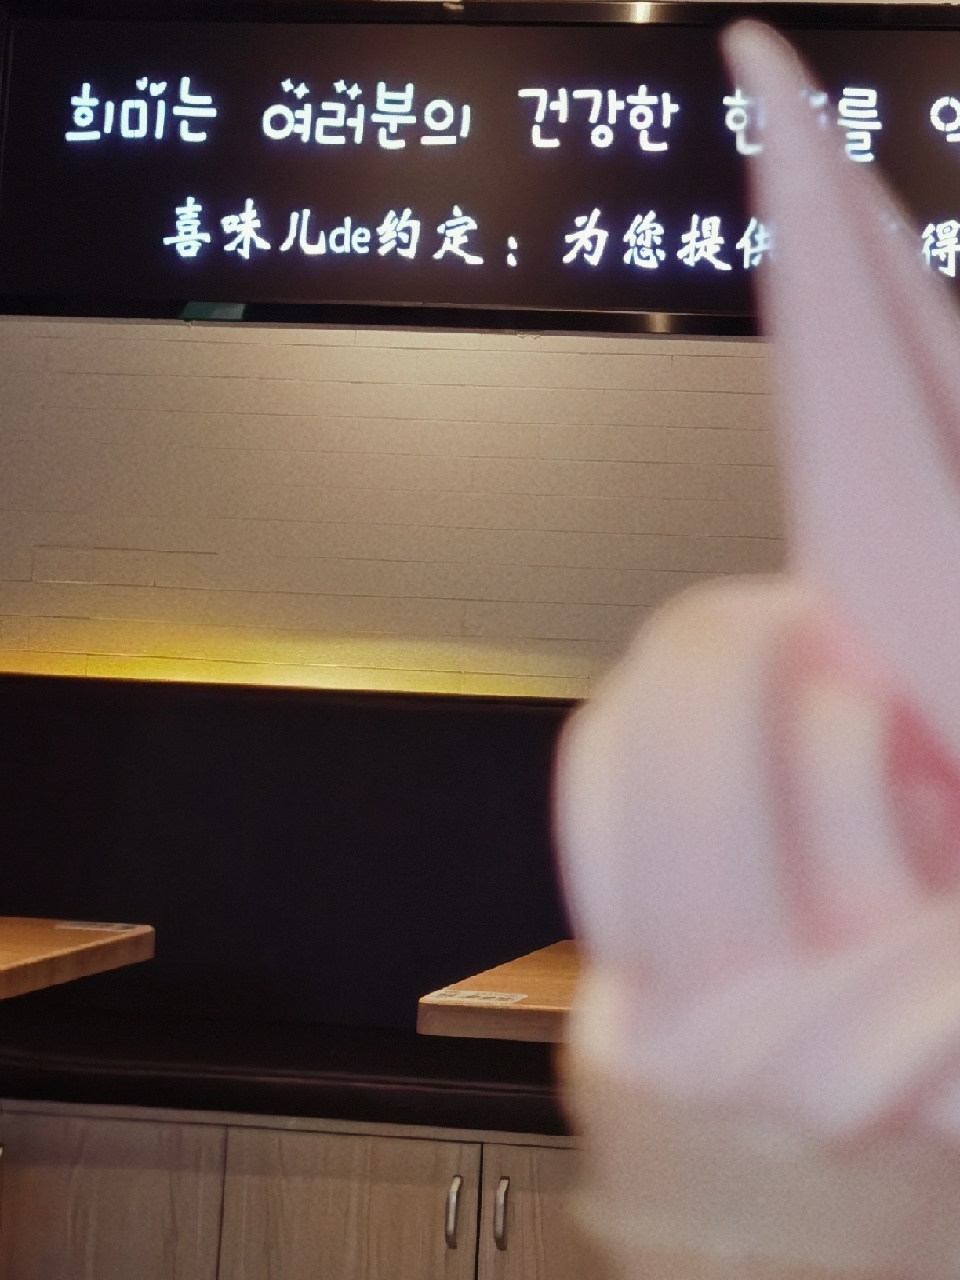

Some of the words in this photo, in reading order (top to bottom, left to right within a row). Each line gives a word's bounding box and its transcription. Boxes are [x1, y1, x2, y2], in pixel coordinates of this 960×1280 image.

[65, 77, 217, 142] 희미는
[263, 78, 470, 150] 여러분의
[518, 85, 679, 151] 건강한
[722, 87, 882, 163] 한를
